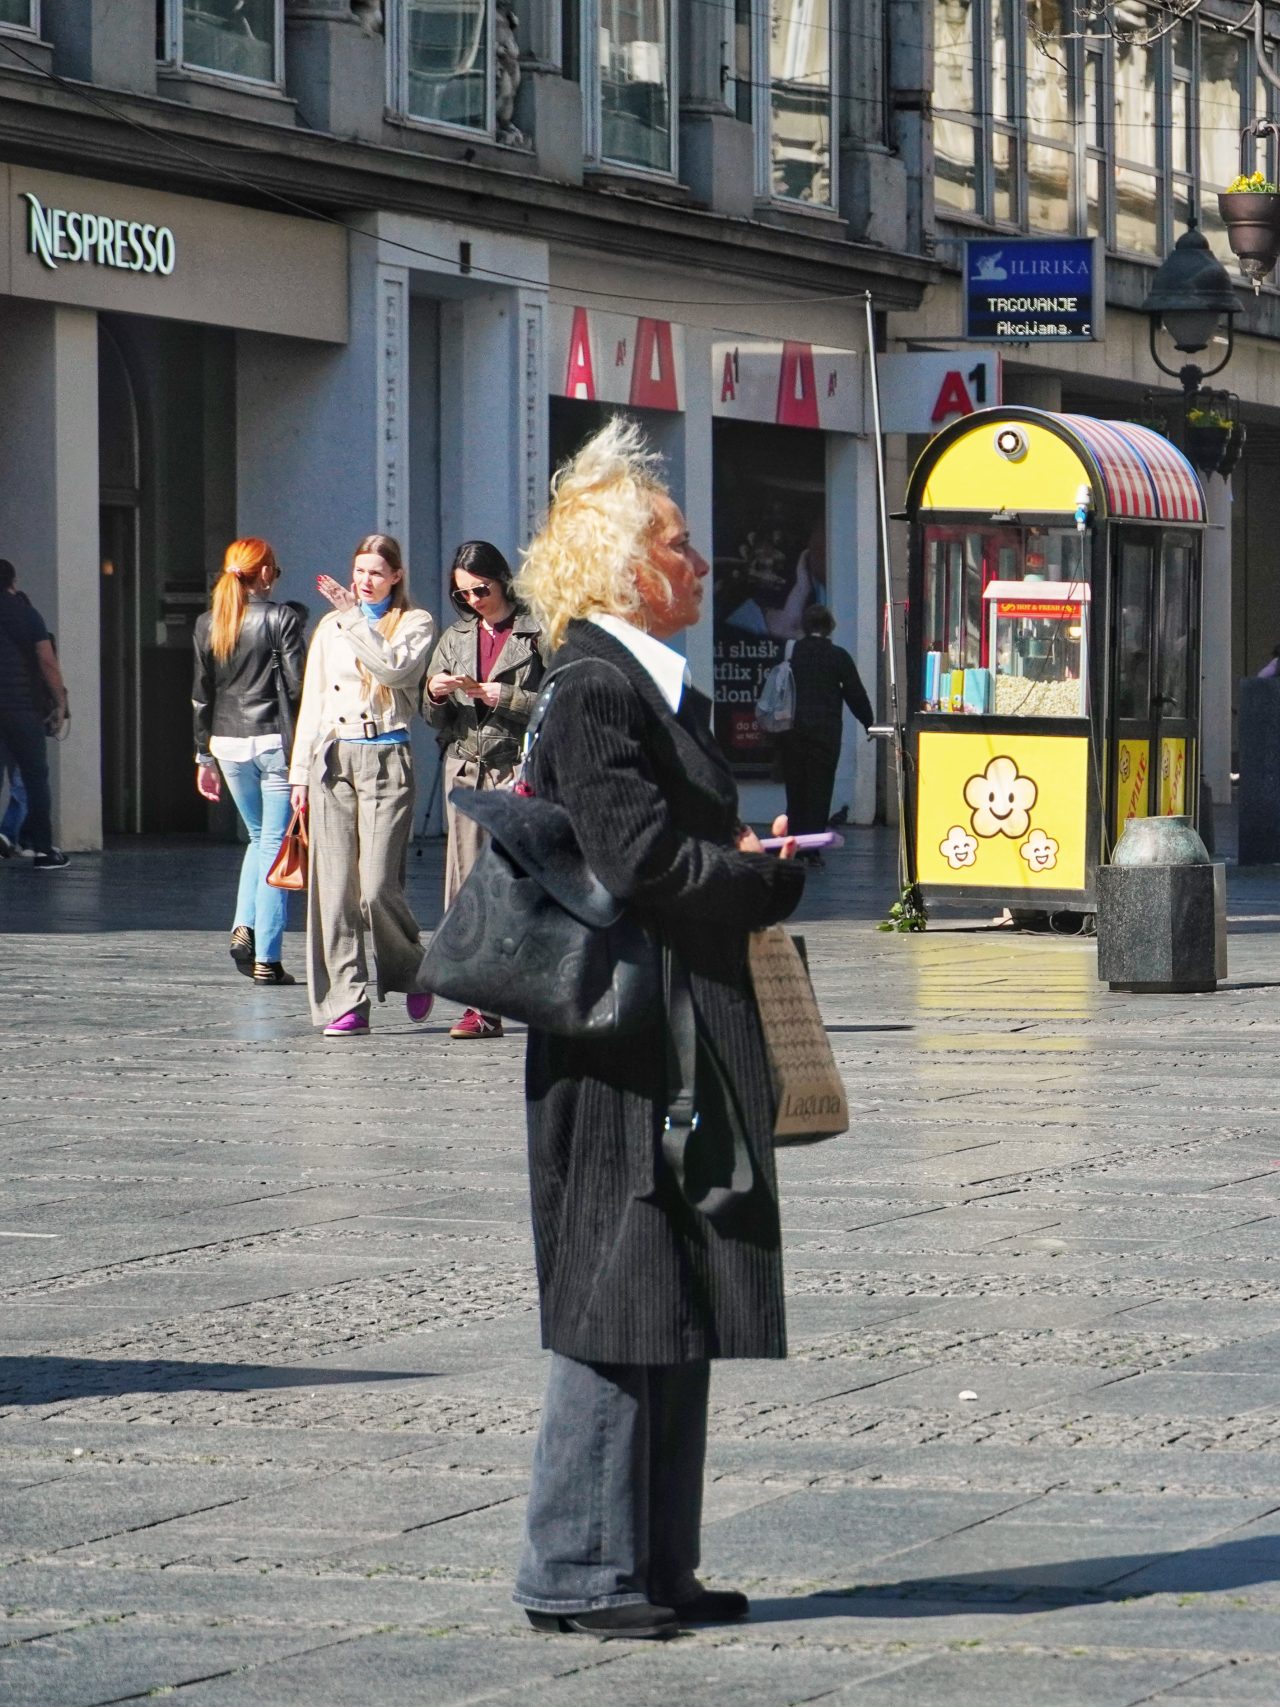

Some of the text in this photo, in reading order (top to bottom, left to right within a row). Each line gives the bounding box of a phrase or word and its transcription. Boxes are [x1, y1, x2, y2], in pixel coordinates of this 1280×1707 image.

[25, 192, 175, 275] NESPRESSO
[1011, 260, 1089, 275] ILIRIKA
[987, 297, 1078, 312] TRGOVANJE
[721, 346, 739, 402] A1
[931, 363, 986, 423] A1
